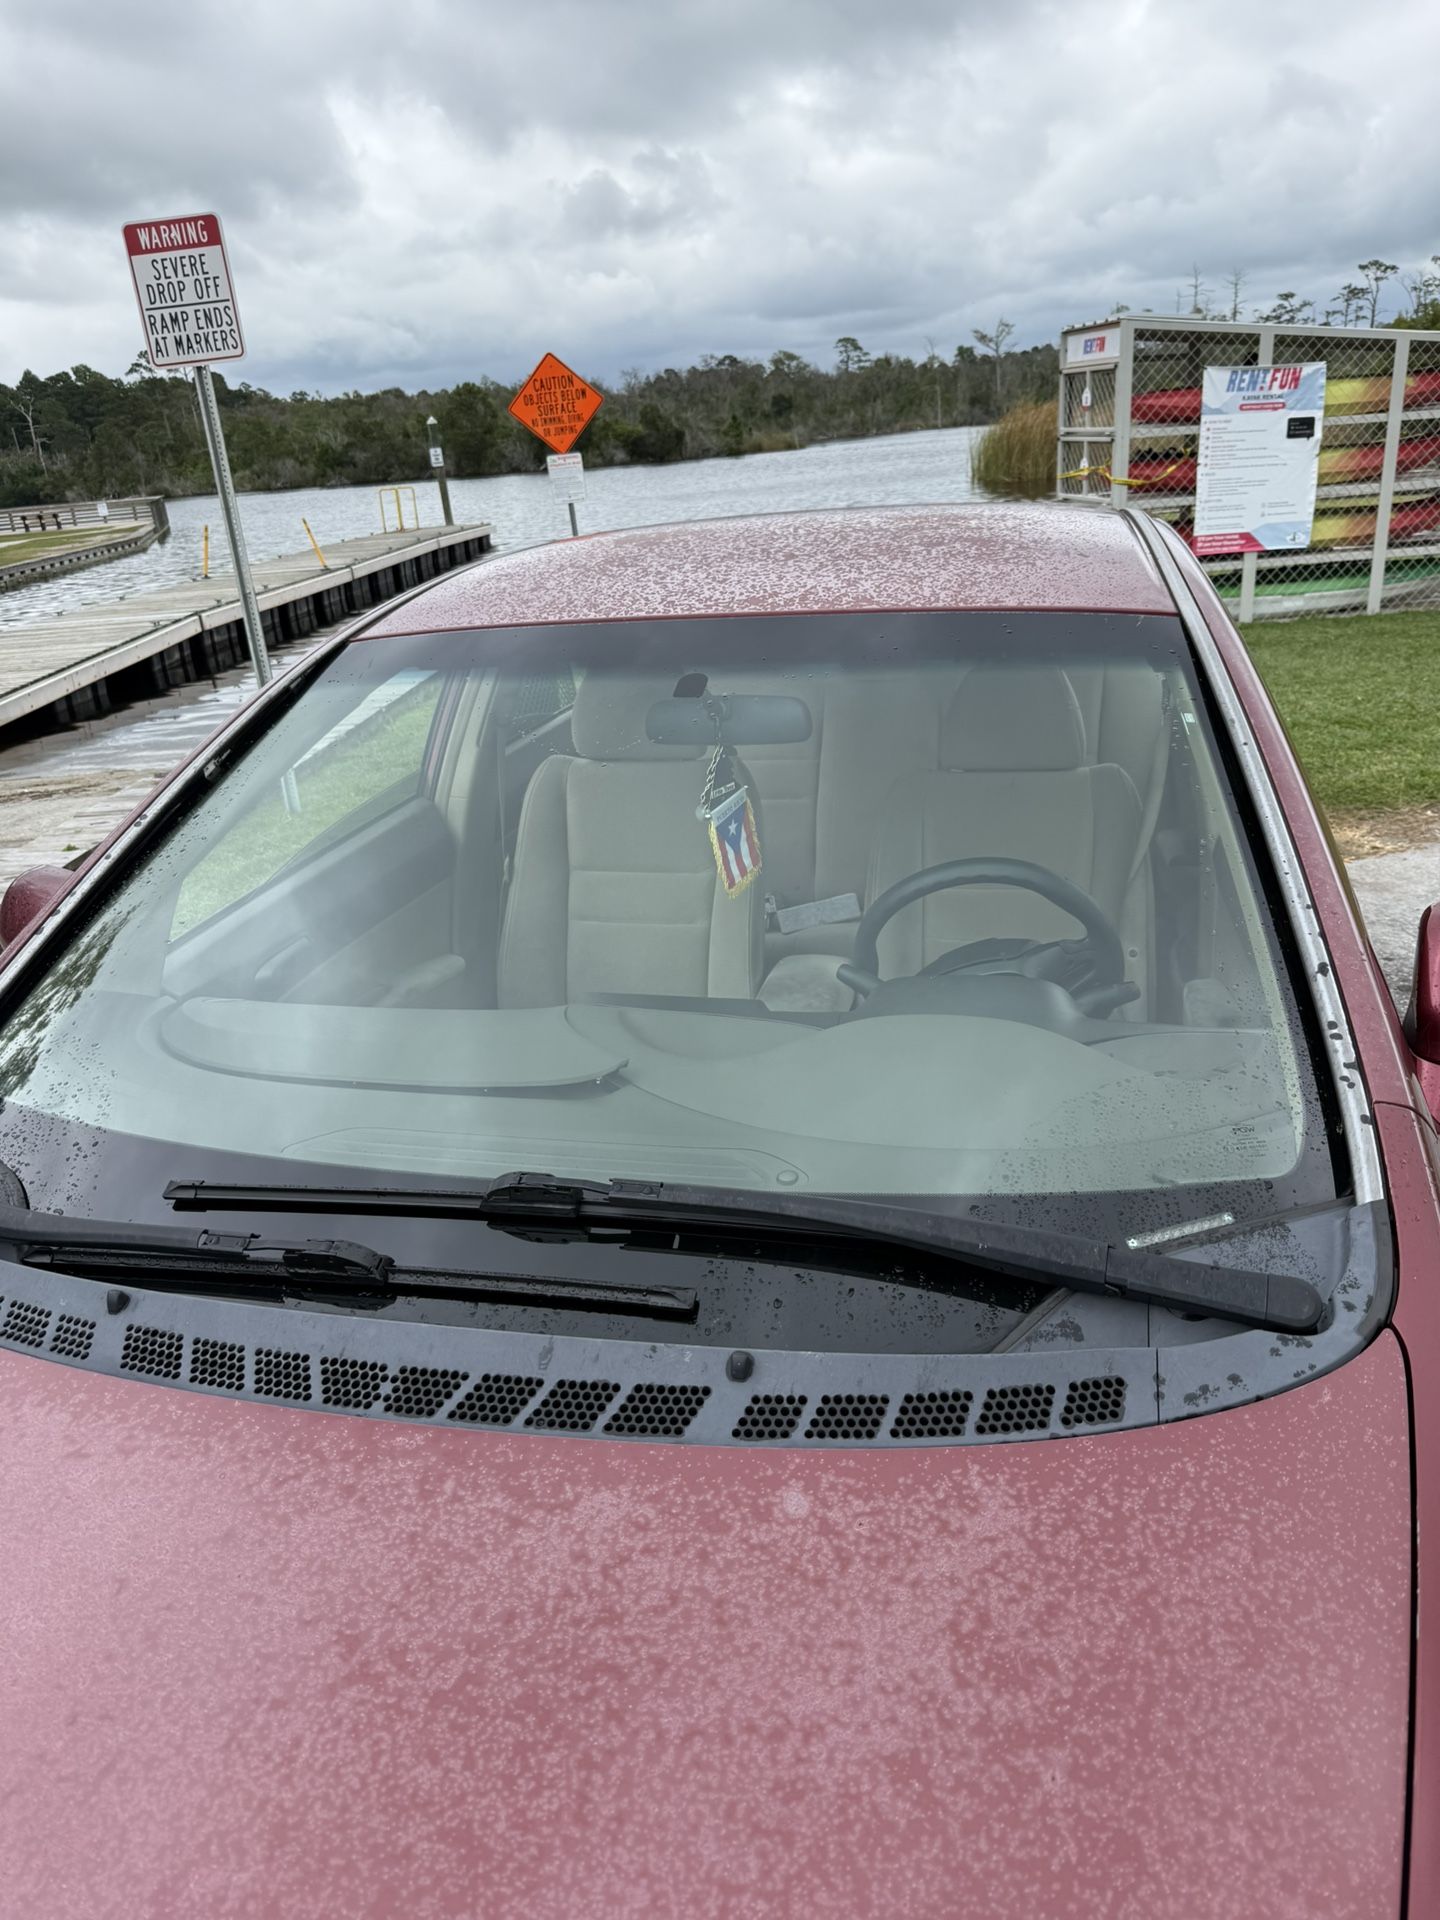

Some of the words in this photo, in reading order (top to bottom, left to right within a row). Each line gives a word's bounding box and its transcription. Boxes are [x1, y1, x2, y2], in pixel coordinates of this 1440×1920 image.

[136, 220, 208, 250] WARNING
[151, 253, 209, 281] SEVERE
[146, 280, 186, 305] DROP
[194, 276, 220, 300] OFF
[148, 310, 189, 335] RAMP
[195, 305, 234, 330] ENDS
[155, 336, 170, 358] AT
[174, 328, 239, 356] MARKERS
[523, 391, 557, 406] OBJECTS
[561, 388, 587, 402] BELOW
[532, 375, 575, 392] CAUTION
[537, 401, 577, 416] SURFACE
